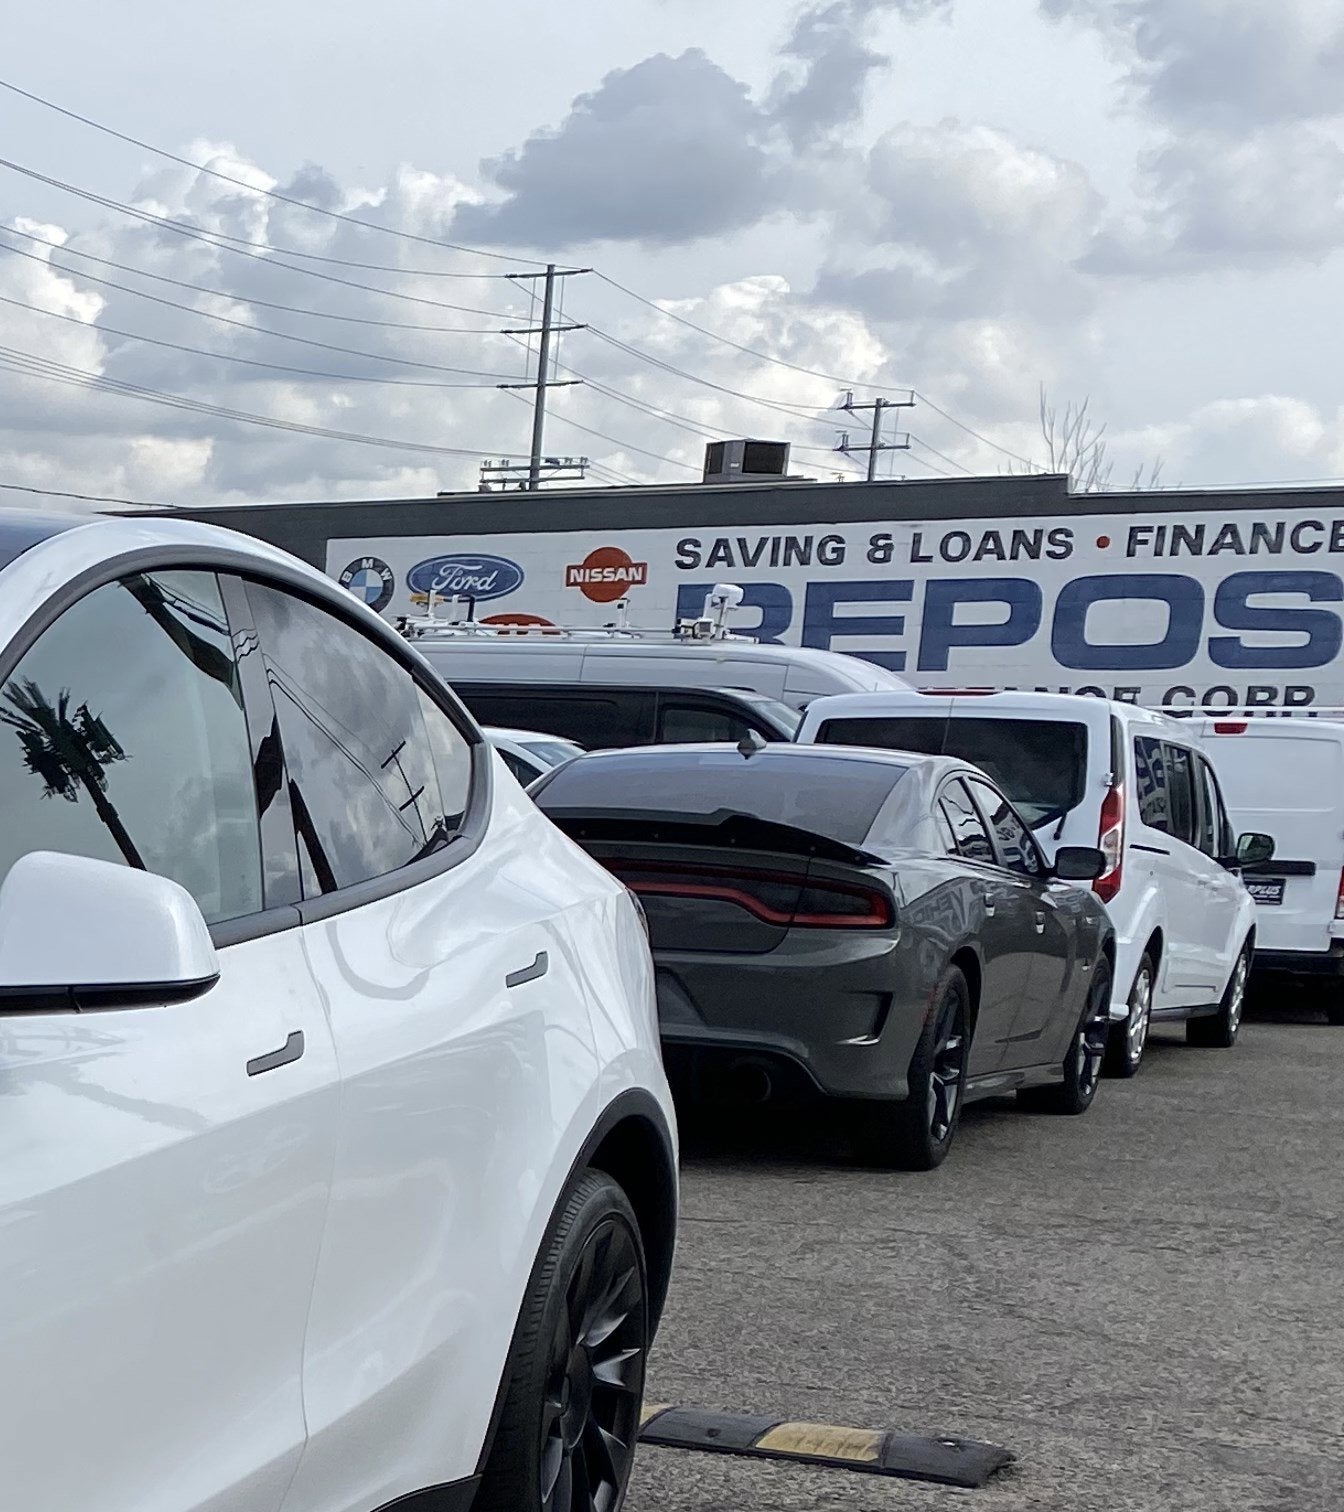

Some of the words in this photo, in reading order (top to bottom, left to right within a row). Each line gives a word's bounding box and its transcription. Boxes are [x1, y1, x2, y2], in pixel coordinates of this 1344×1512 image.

[674, 533, 846, 570] SAVING
[865, 533, 894, 564] &
[910, 527, 1075, 563] LOANS
[432, 563, 498, 592] Ford
[569, 565, 644, 583] NISSAN
[674, 570, 1344, 673] REPOS
